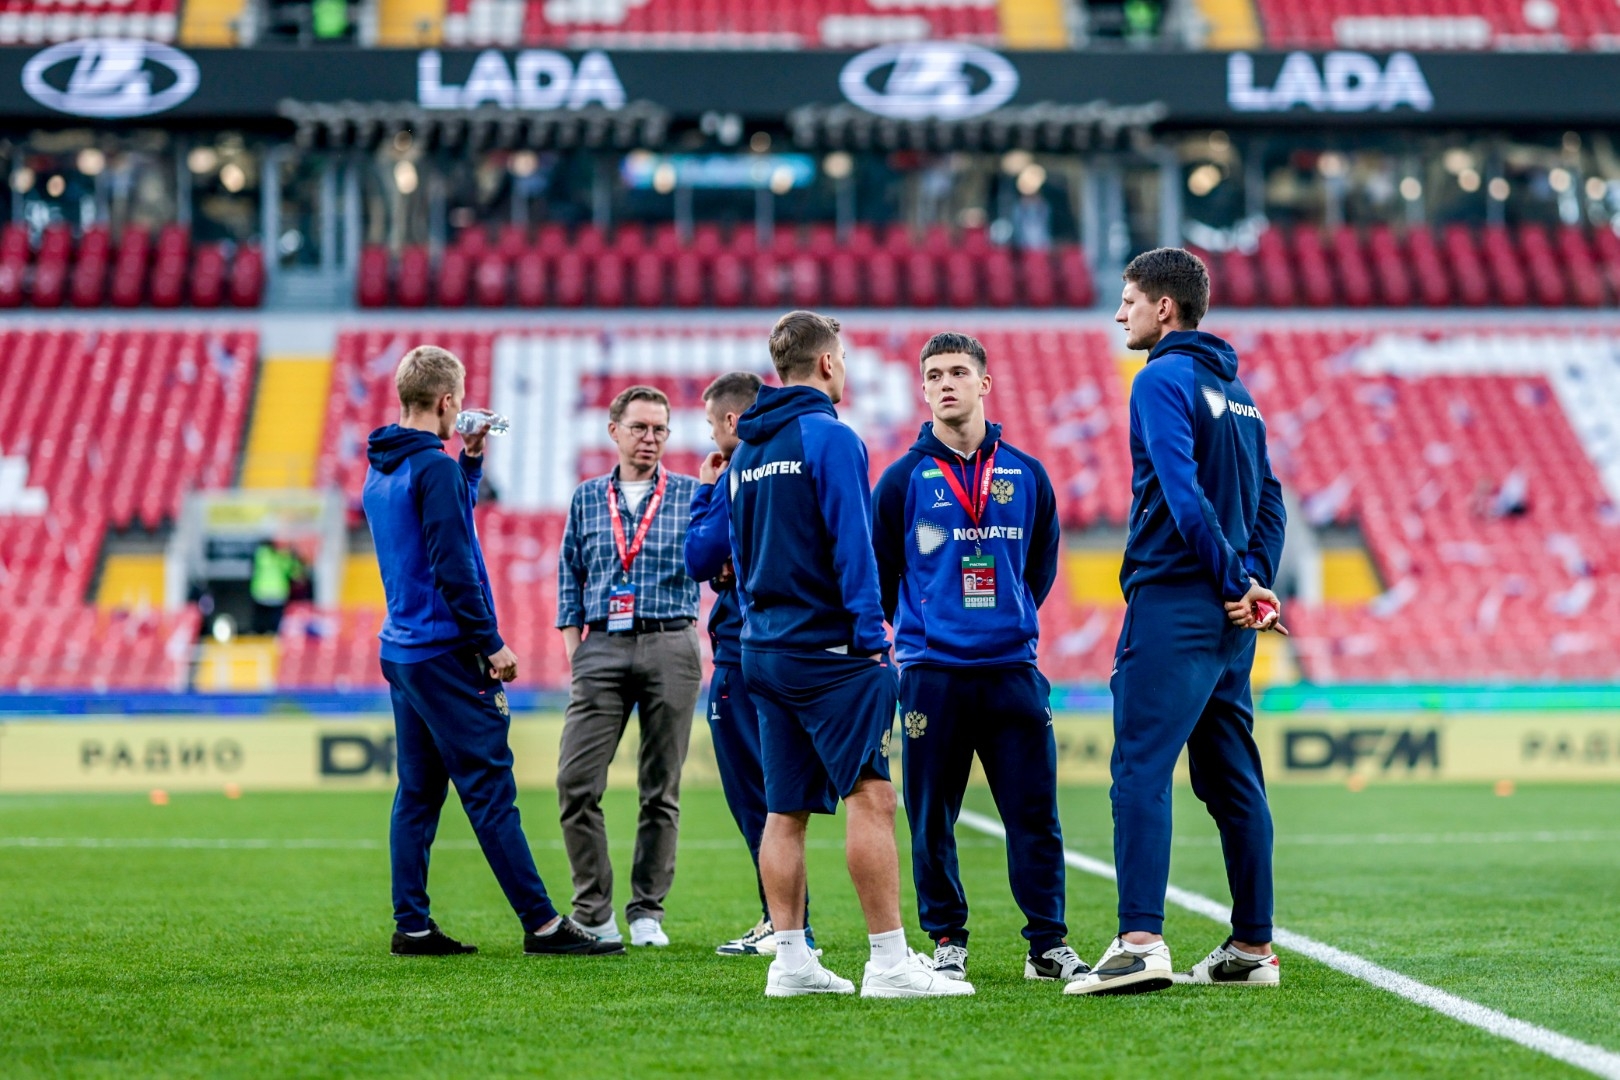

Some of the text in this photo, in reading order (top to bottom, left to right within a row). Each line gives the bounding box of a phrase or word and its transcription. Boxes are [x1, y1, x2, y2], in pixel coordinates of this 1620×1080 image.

[418, 49, 627, 111] LADA
[1227, 51, 1435, 112] LADA
[741, 460, 803, 483] NOVATEK
[80, 738, 245, 773] РАДИО
[1283, 728, 1441, 771] DFM
[1522, 731, 1620, 764] РАД
